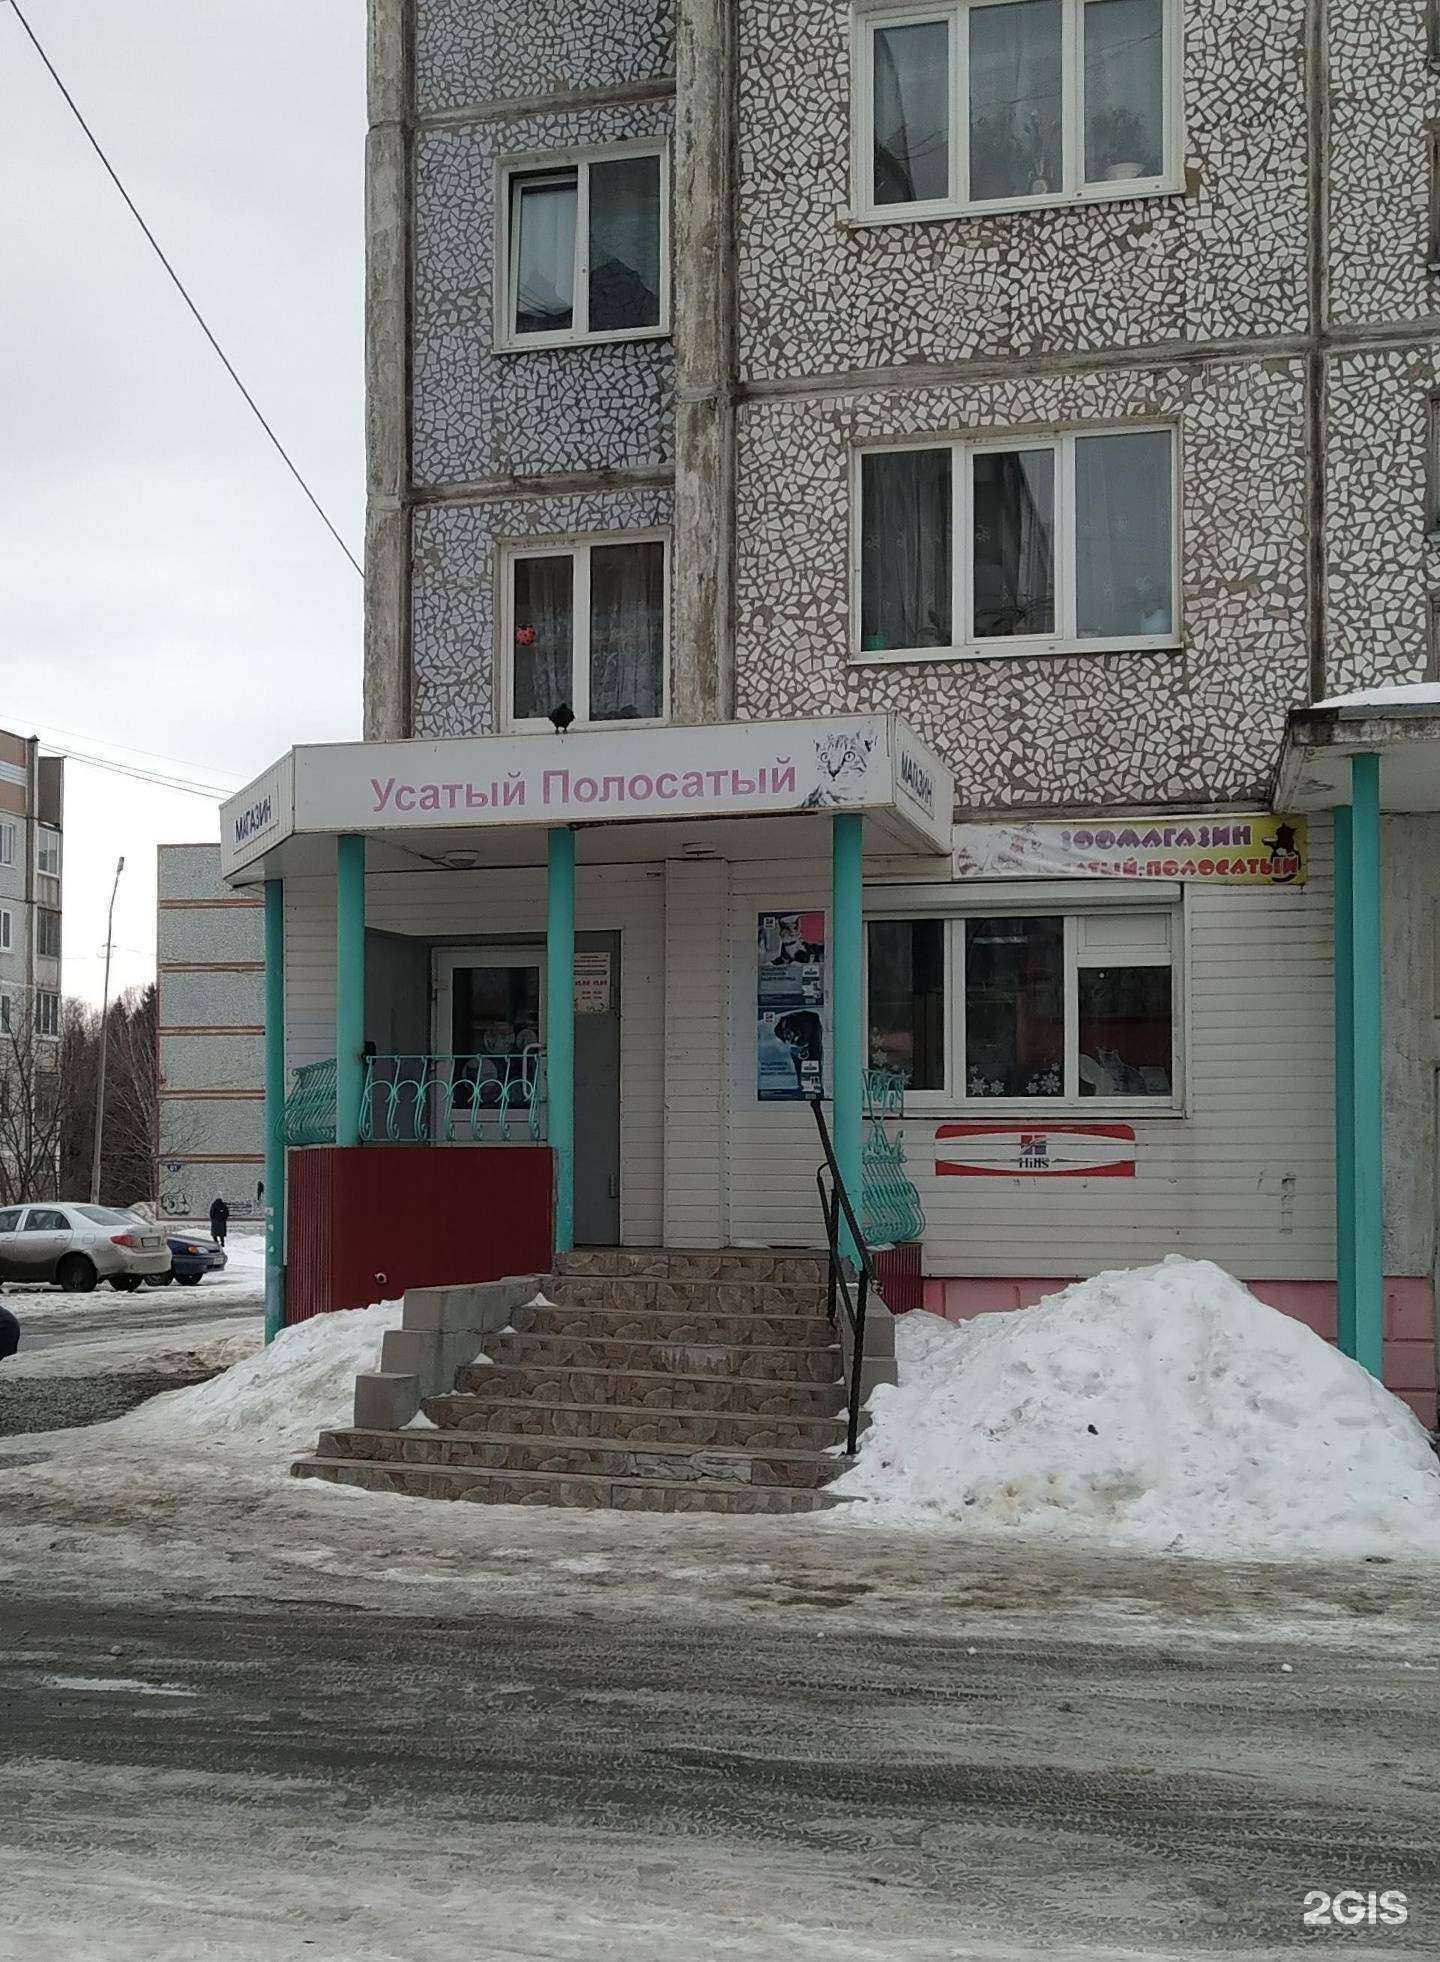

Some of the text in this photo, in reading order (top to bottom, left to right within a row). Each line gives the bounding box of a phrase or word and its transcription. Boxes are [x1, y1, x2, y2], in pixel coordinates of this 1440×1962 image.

[370, 756, 796, 812] Усатый Полосатый
[235, 795, 272, 843] МАГАЗИН
